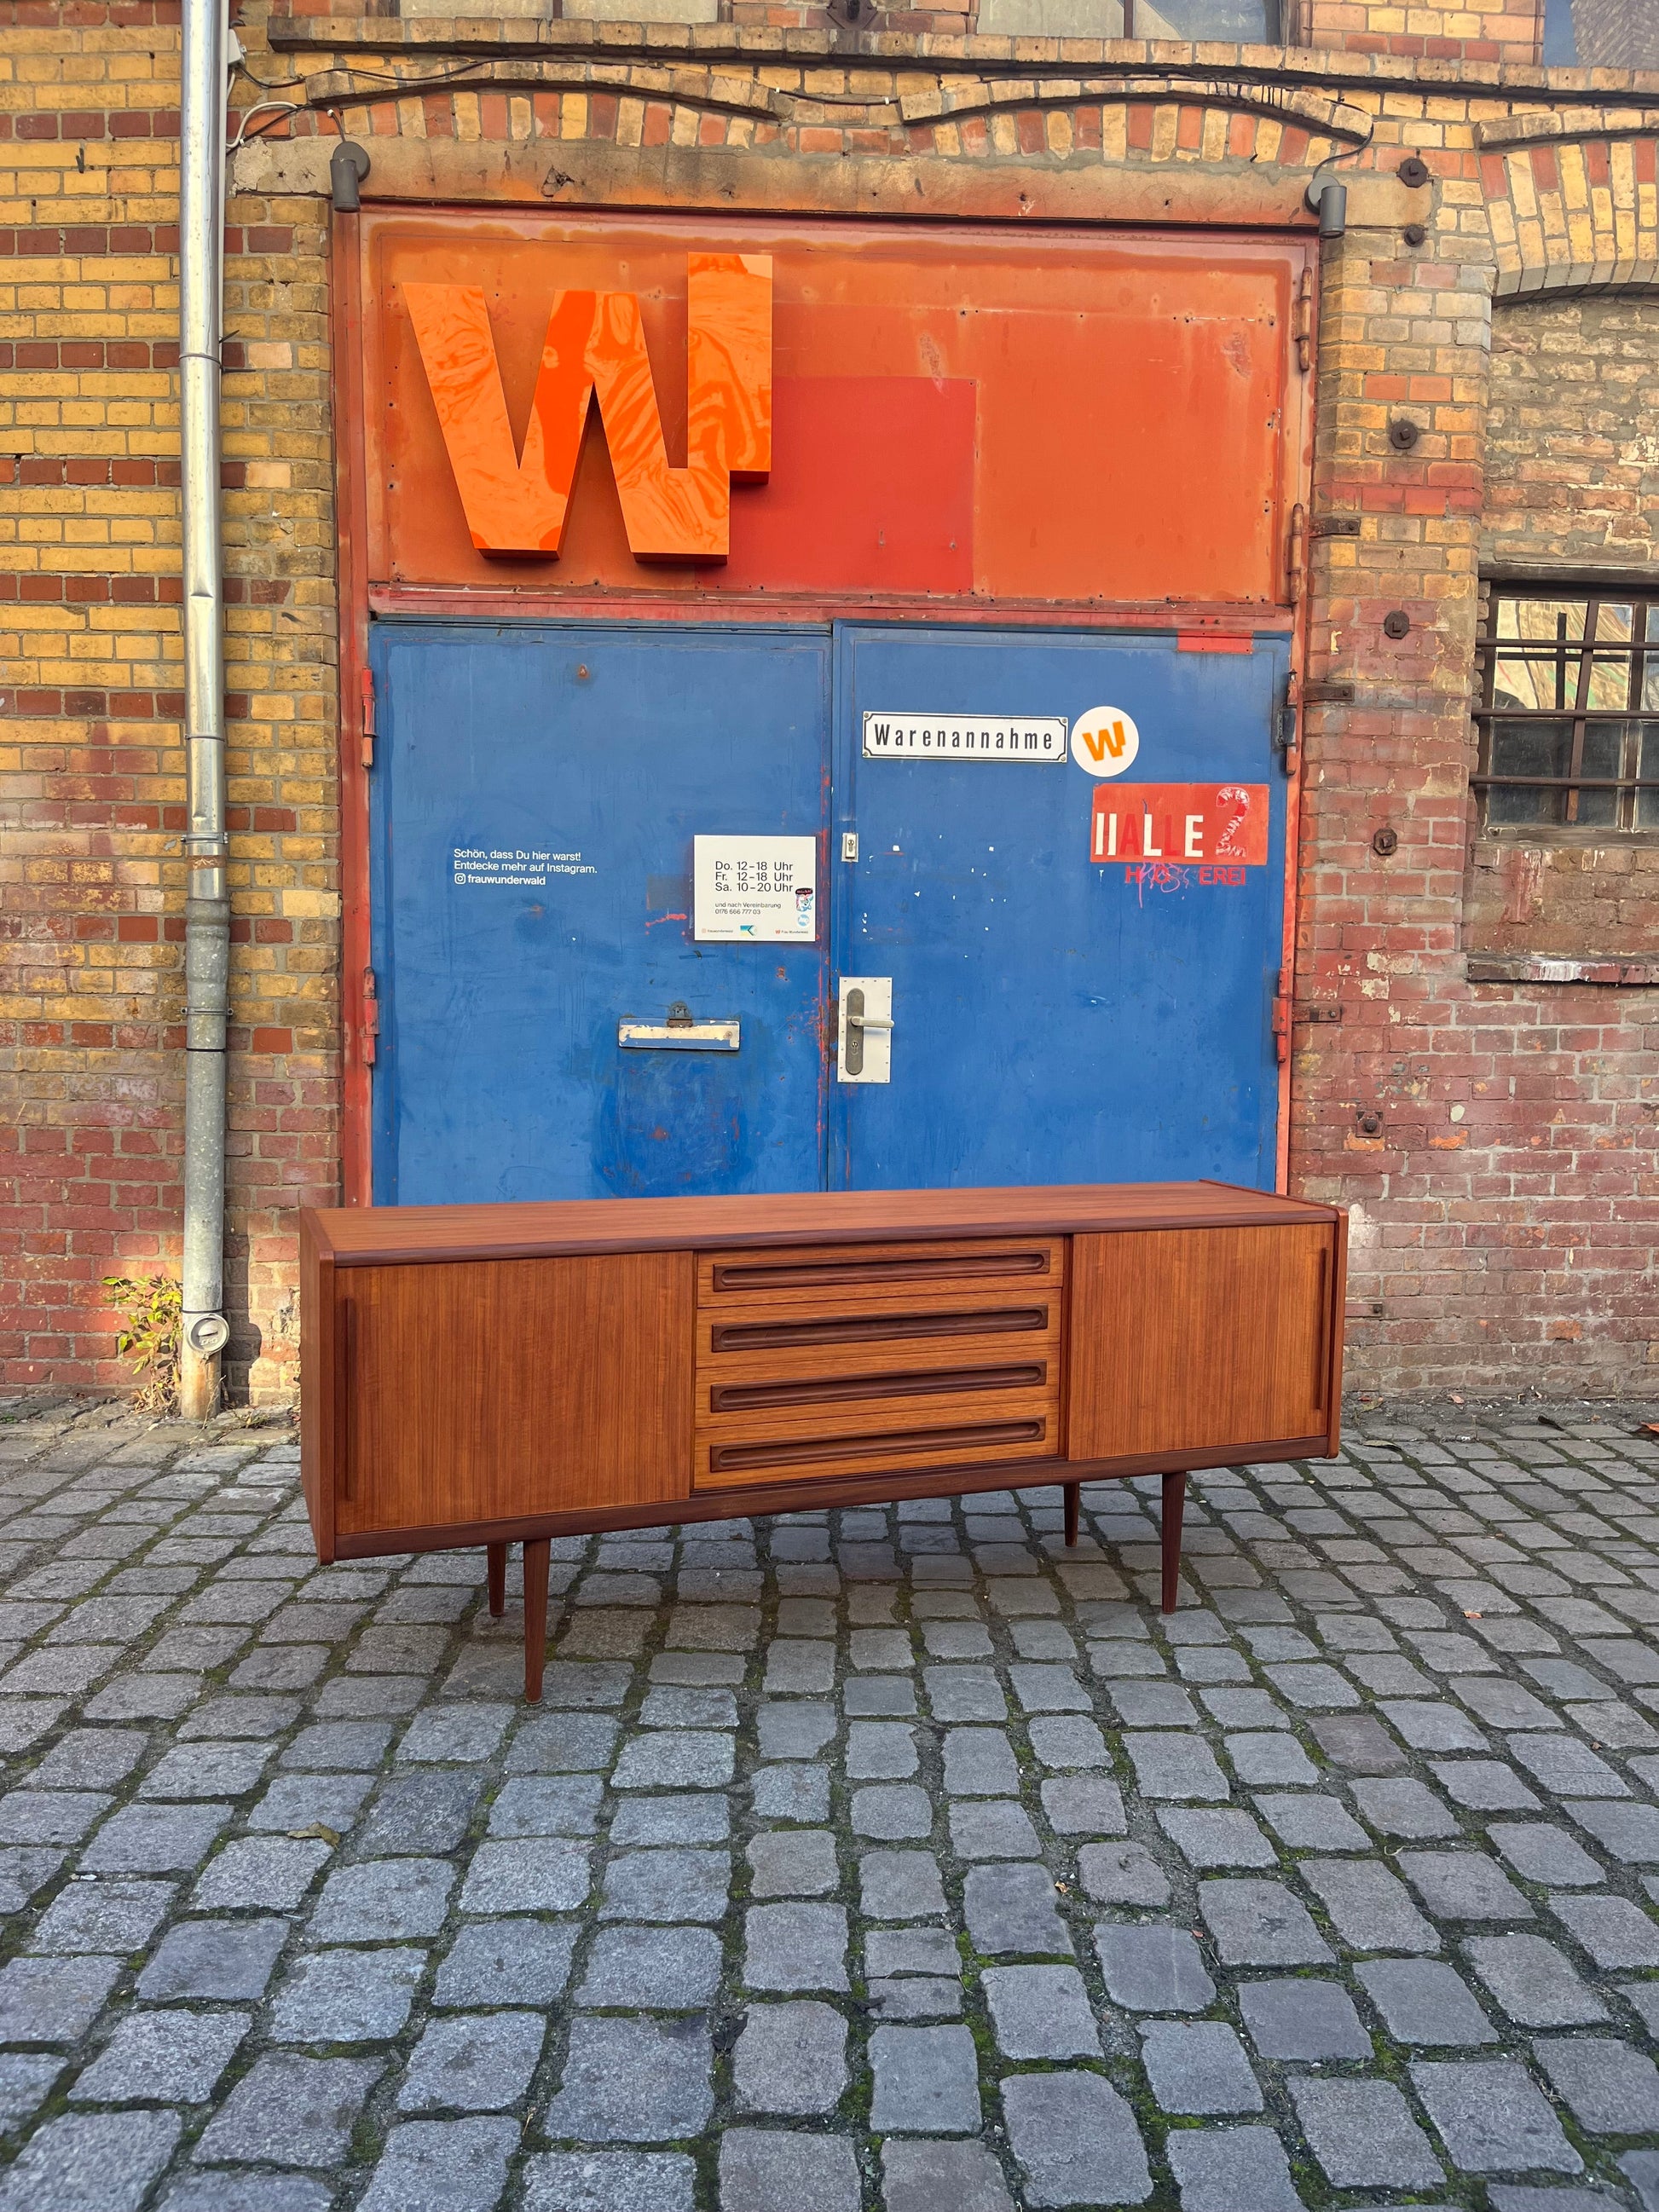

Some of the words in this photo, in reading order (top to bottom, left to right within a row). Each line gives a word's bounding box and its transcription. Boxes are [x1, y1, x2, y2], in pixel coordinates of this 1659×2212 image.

[875, 723, 1053, 750] Warenannahme
[1215, 786, 1251, 858] 2
[454, 848, 488, 860] Schön,
[490, 850, 513, 859] dass
[516, 850, 530, 860] Du
[532, 851, 551, 860] hier
[552, 852, 581, 861] warst!
[454, 860, 500, 870] Entdecke
[501, 863, 527, 871] mehr
[529, 863, 545, 872] auf
[546, 863, 598, 875] Instagram.
[715, 860, 732, 870] Do.
[774, 862, 793, 871] Uhr
[467, 874, 546, 886] frauwunderwald
[715, 871, 728, 881] Fr.
[774, 872, 793, 881] Uhr
[715, 881, 732, 892] Sa.
[774, 882, 793, 892] Uhr
